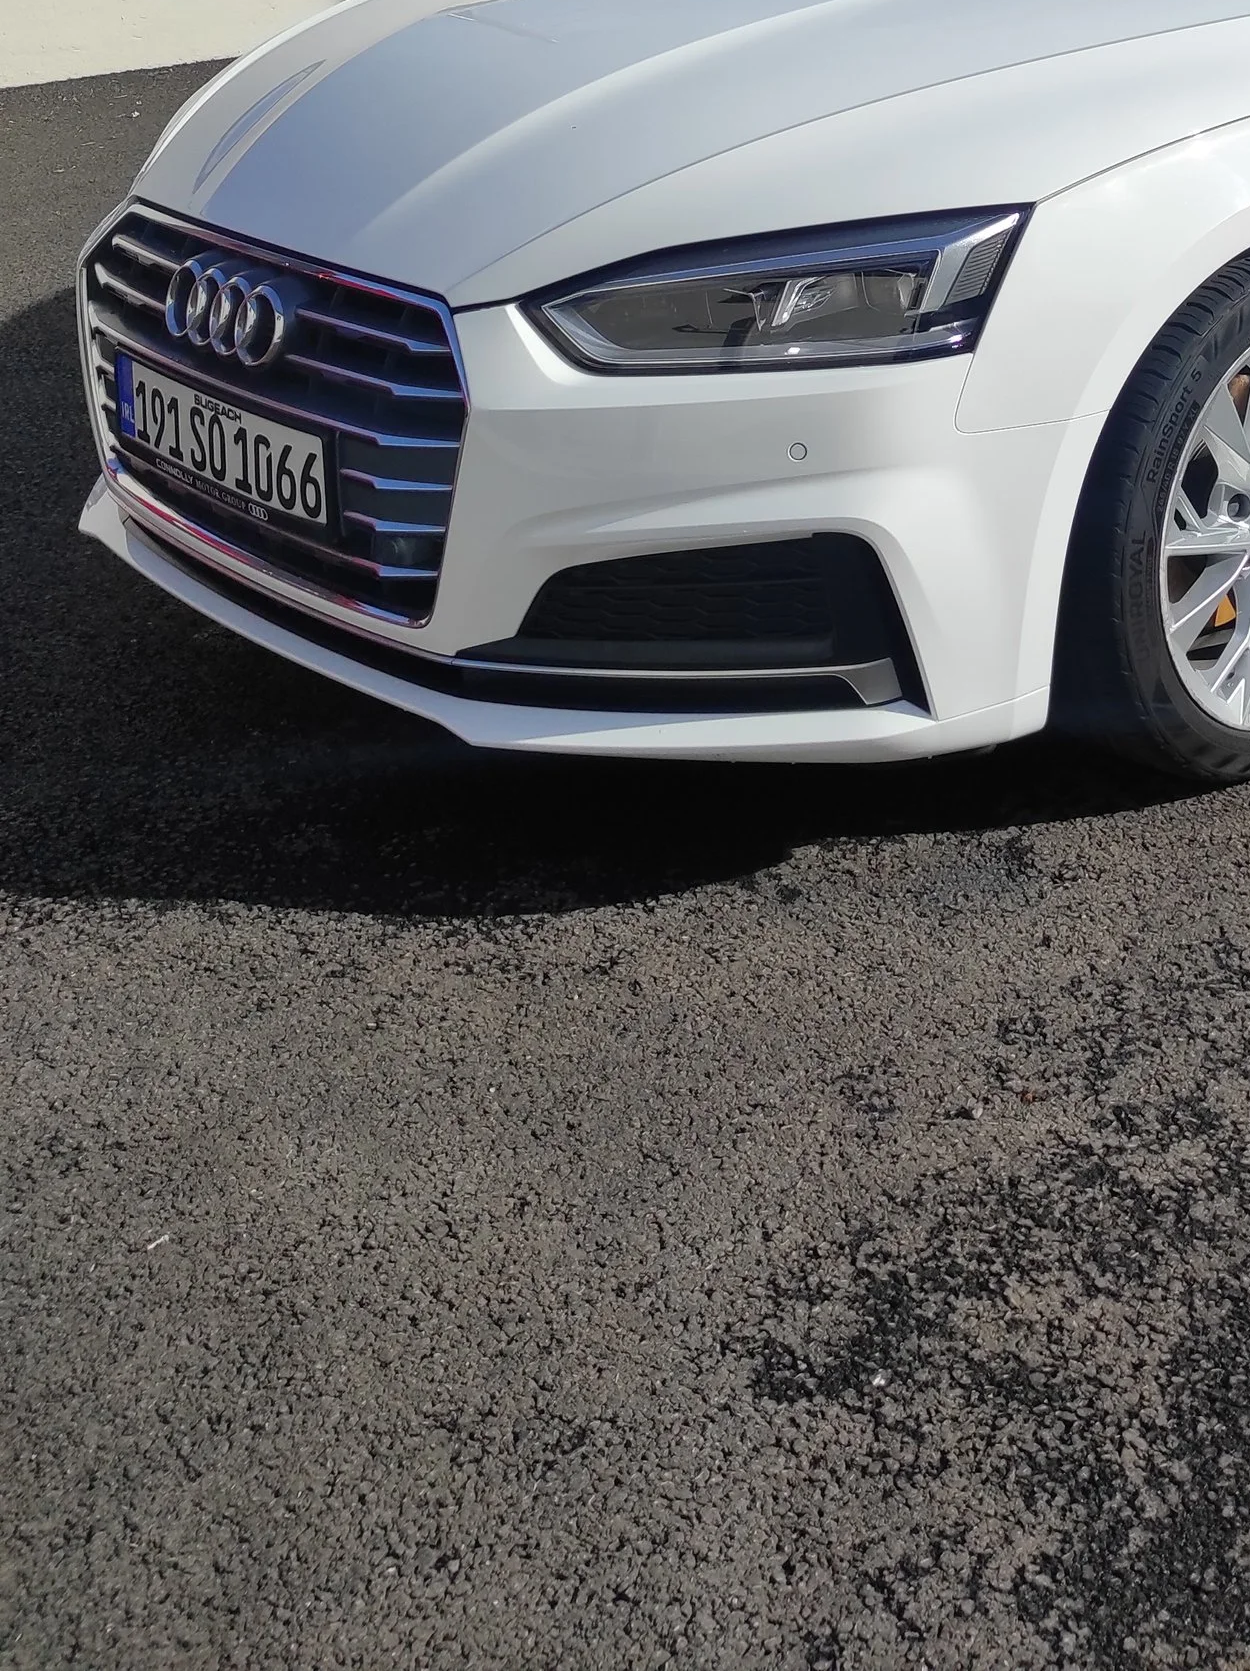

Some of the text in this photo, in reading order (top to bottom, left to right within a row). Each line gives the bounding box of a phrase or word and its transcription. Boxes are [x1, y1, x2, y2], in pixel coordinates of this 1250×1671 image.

[121, 400, 136, 425] IRL
[135, 380, 323, 519] 191 SO 1066
[1146, 368, 1202, 484] RainSport 5
[155, 458, 247, 510] CONNOLLY MOTOR GROUP
